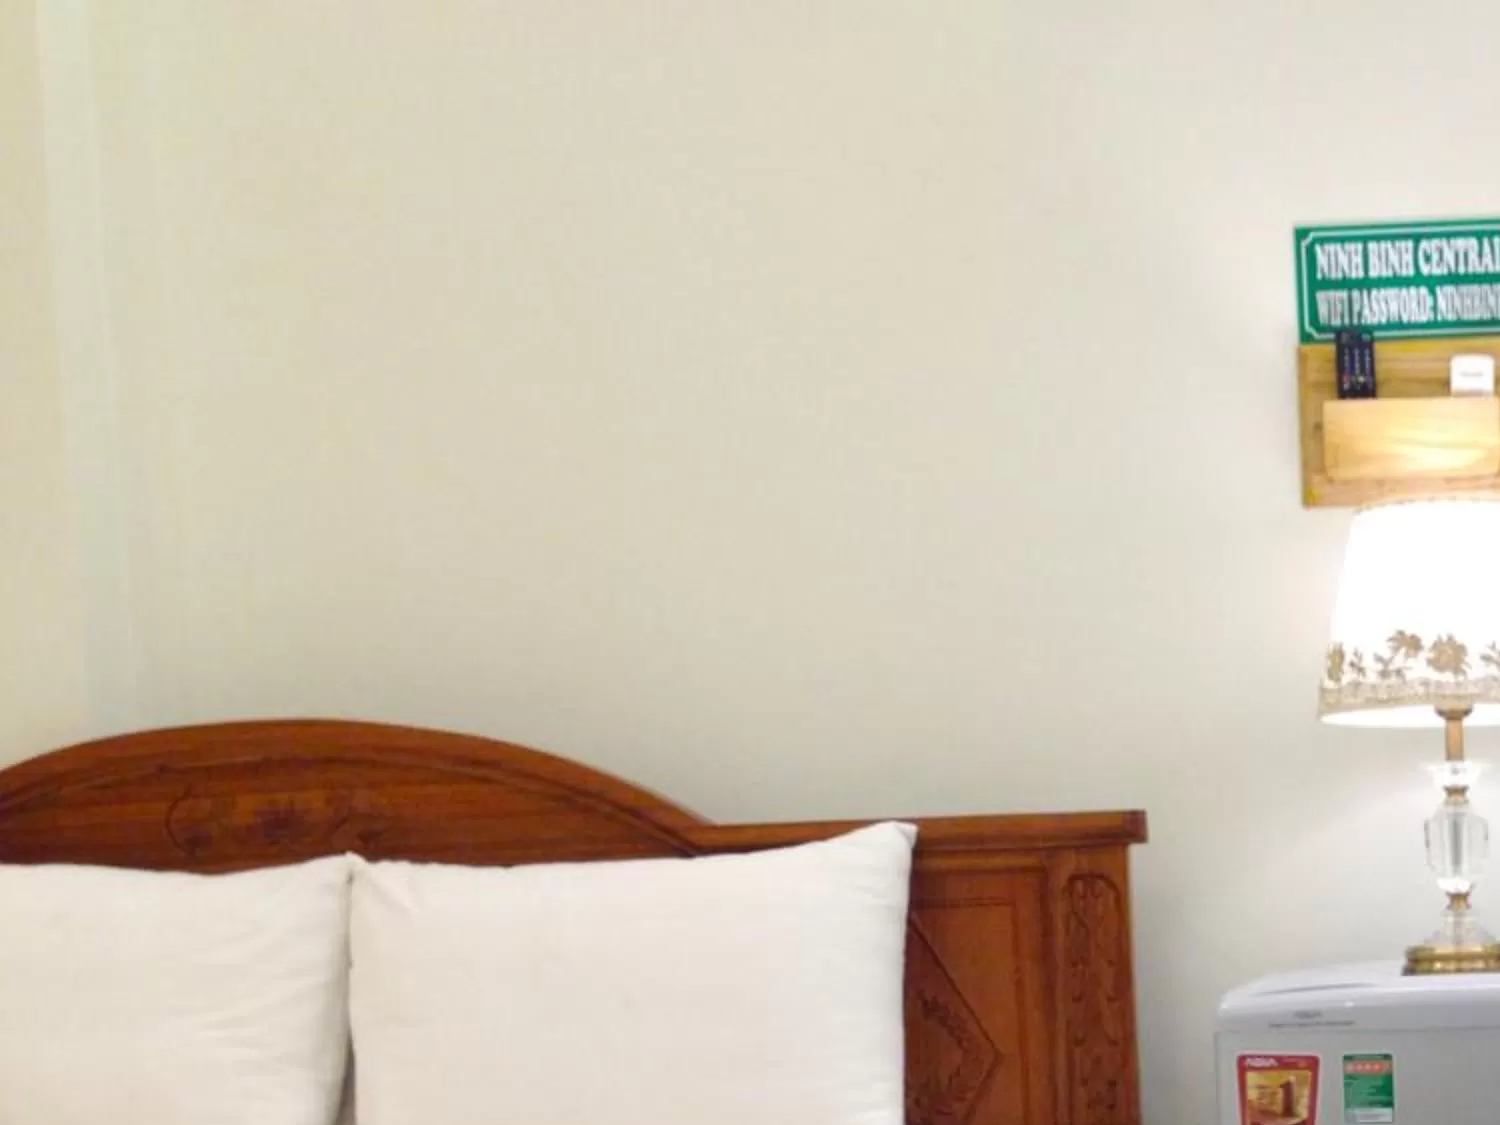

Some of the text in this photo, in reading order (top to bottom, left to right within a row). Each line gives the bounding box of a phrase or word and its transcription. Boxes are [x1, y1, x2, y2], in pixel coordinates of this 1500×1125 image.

[1315, 241, 1364, 279] NINH
[1368, 239, 1415, 278] BINH
[1315, 291, 1349, 326] WIFI
[1352, 286, 1434, 325] PASSWORD:
